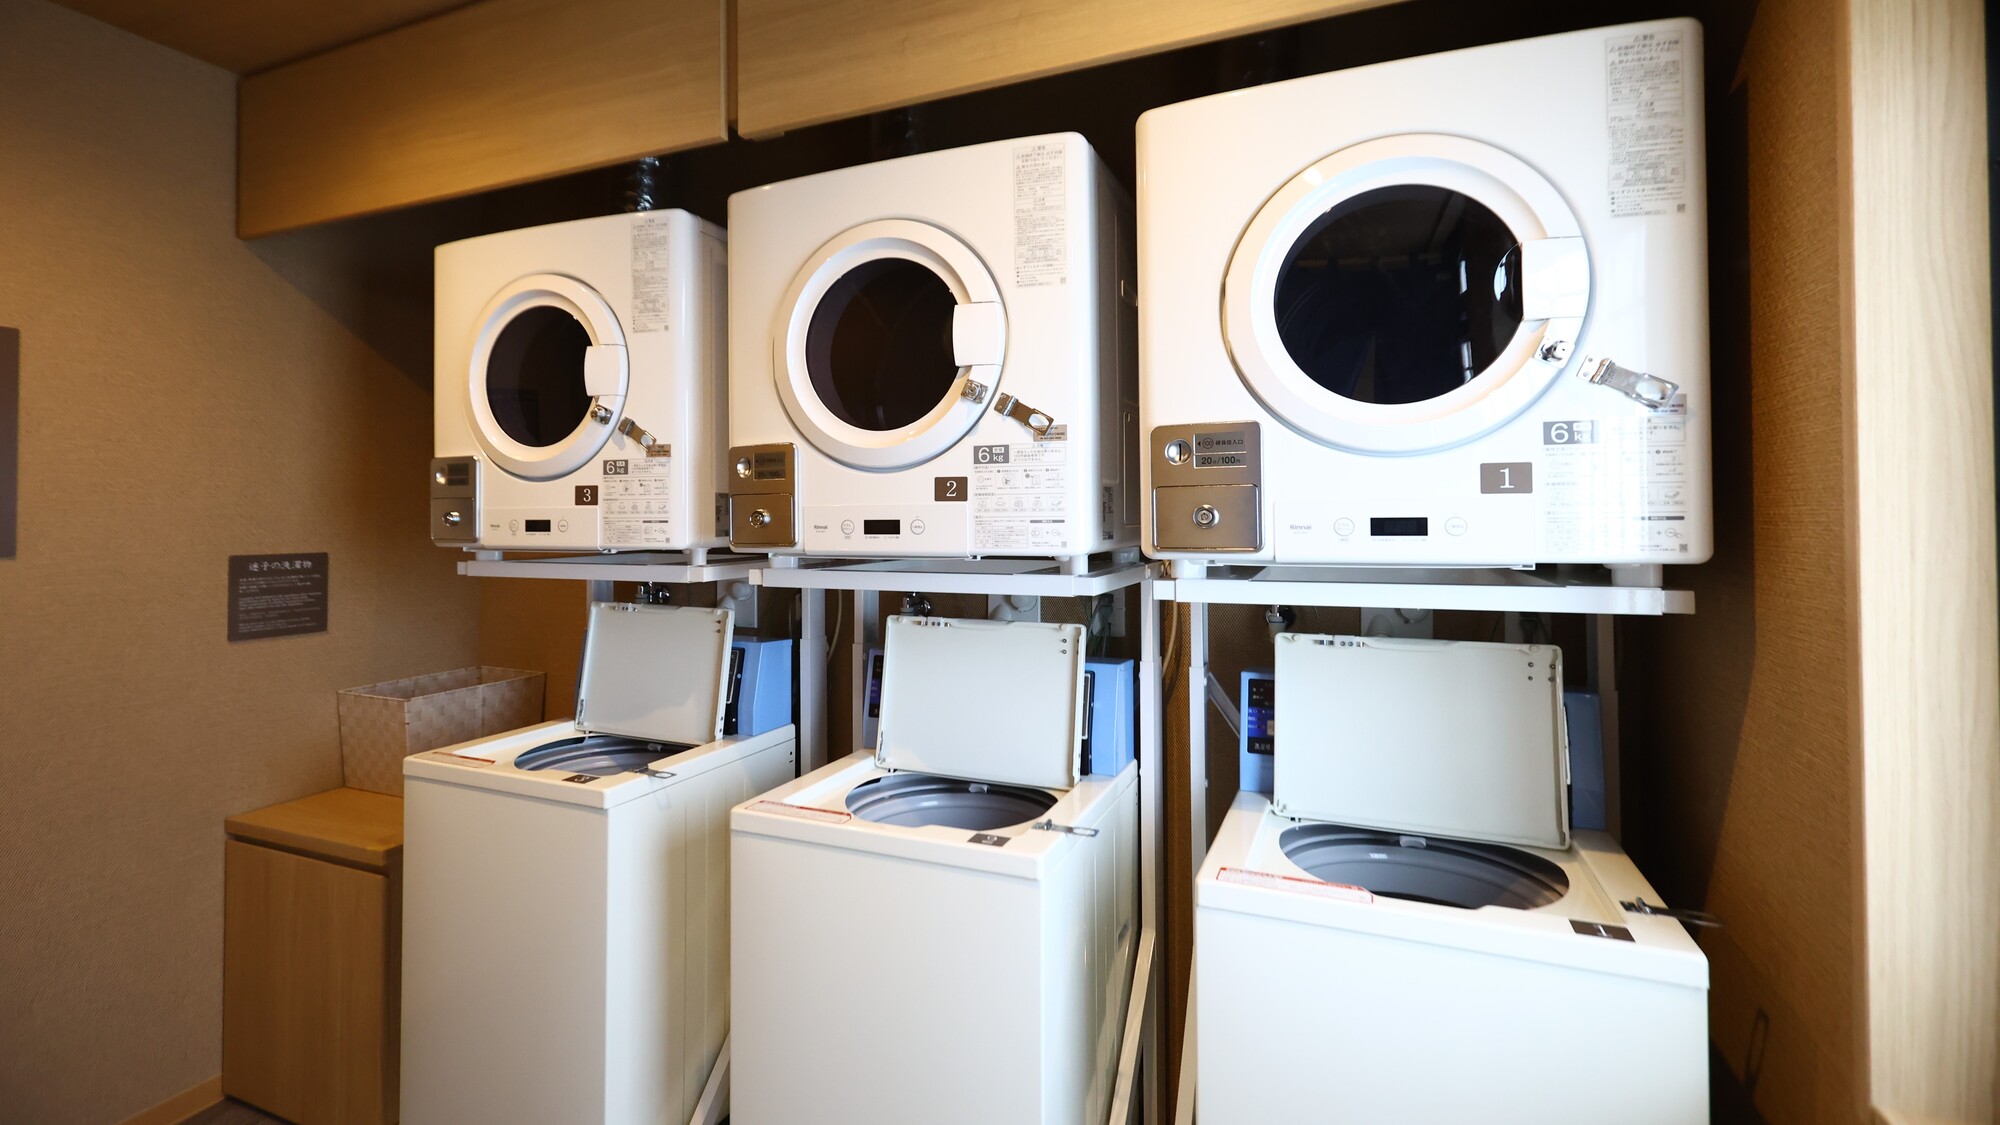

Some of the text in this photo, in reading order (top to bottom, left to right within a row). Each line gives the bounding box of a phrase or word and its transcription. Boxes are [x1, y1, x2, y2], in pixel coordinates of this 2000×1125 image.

[1550, 422, 1569, 444] 6
[978, 447, 990, 463] 6
[992, 454, 1005, 463] kg
[606, 461, 615, 474] 6
[1499, 467, 1515, 489] 1
[583, 488, 592, 503] 3
[946, 481, 957, 497] 2
[248, 560, 312, 572] 迷子の洗濯物
